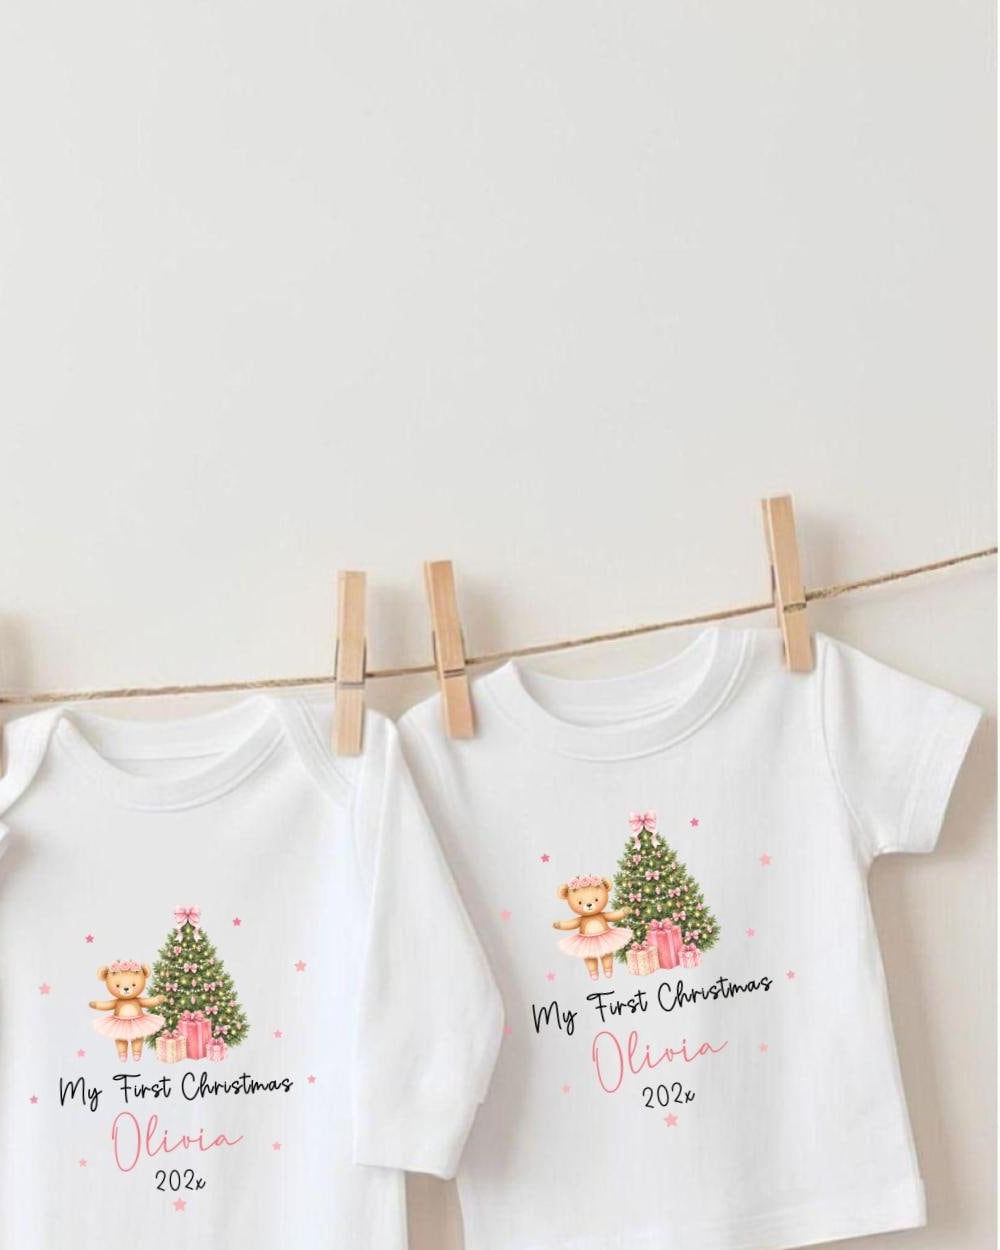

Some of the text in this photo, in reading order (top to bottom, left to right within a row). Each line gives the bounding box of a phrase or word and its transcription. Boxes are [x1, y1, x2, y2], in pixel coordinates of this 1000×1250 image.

[531, 976, 774, 1036] My First Christmas
[592, 1030, 728, 1093] Olivia
[59, 1071, 294, 1113] My First Christmas
[642, 1081, 696, 1109] 202x
[111, 1111, 244, 1172] Olivia
[155, 1168, 206, 1192] 202x
